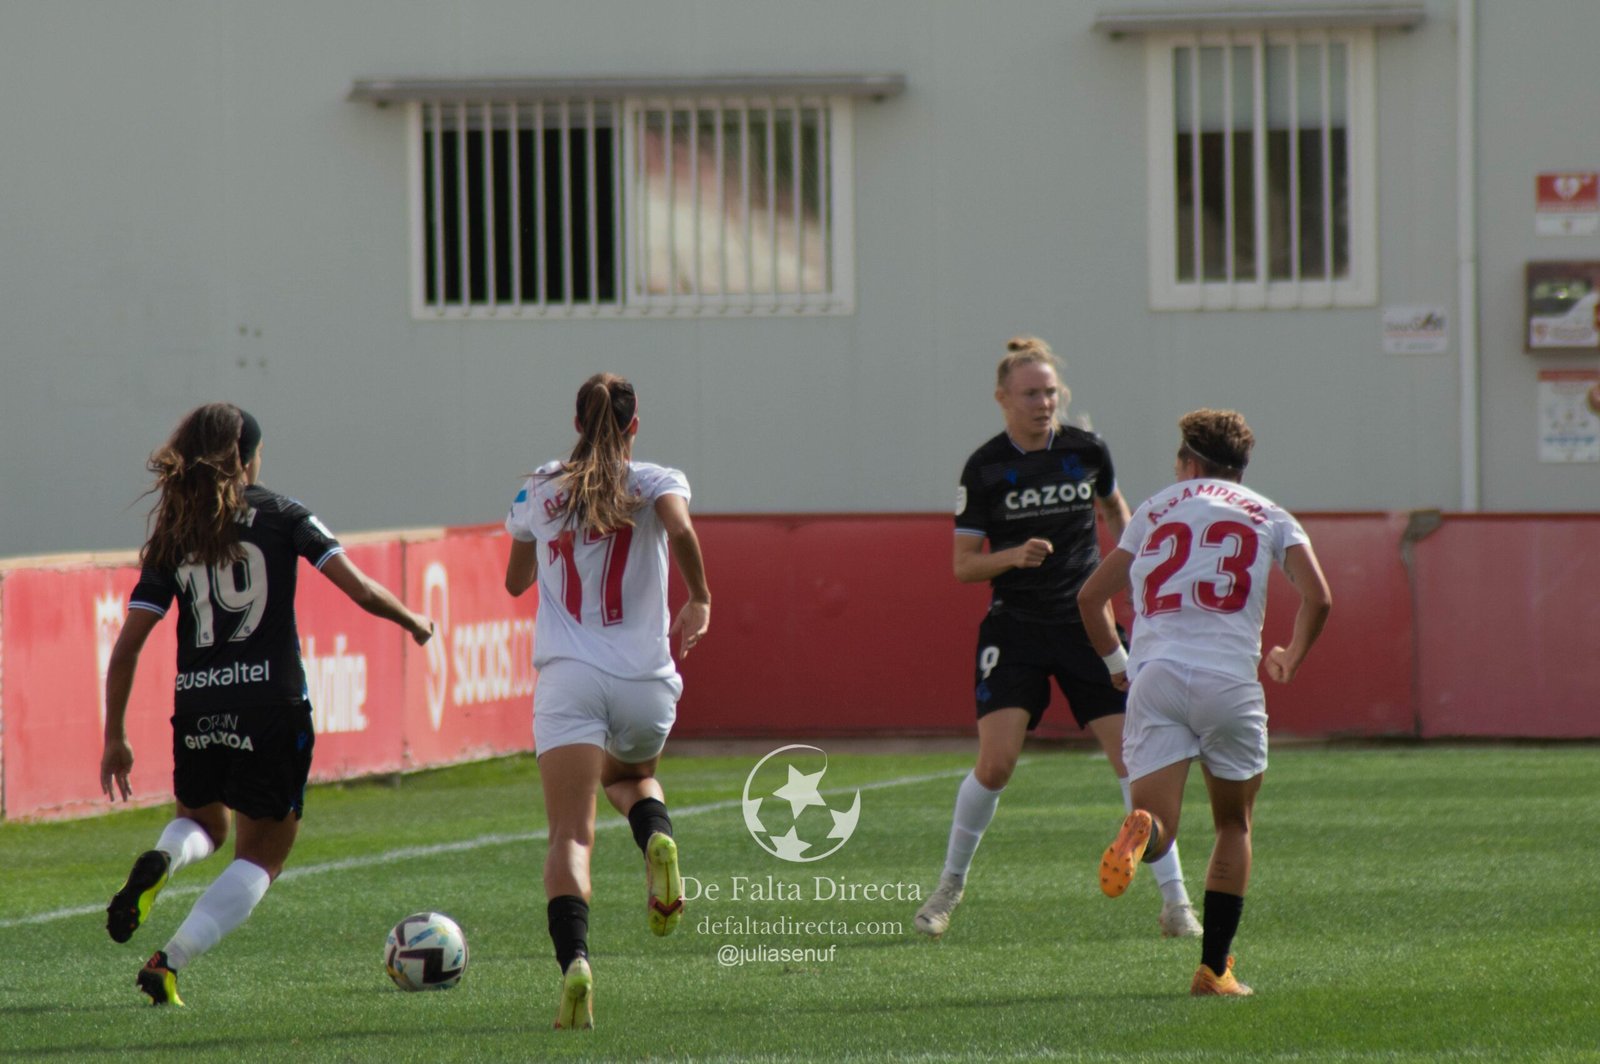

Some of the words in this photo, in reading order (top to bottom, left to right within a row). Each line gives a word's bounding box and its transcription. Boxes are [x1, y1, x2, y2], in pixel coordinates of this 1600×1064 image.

[1005, 482, 1092, 510] CAZOO
[175, 541, 268, 649] 19
[548, 526, 634, 627] 17
[1141, 520, 1260, 618] 23
[175, 659, 270, 692] euskaltel
[980, 645, 1000, 679] 9
